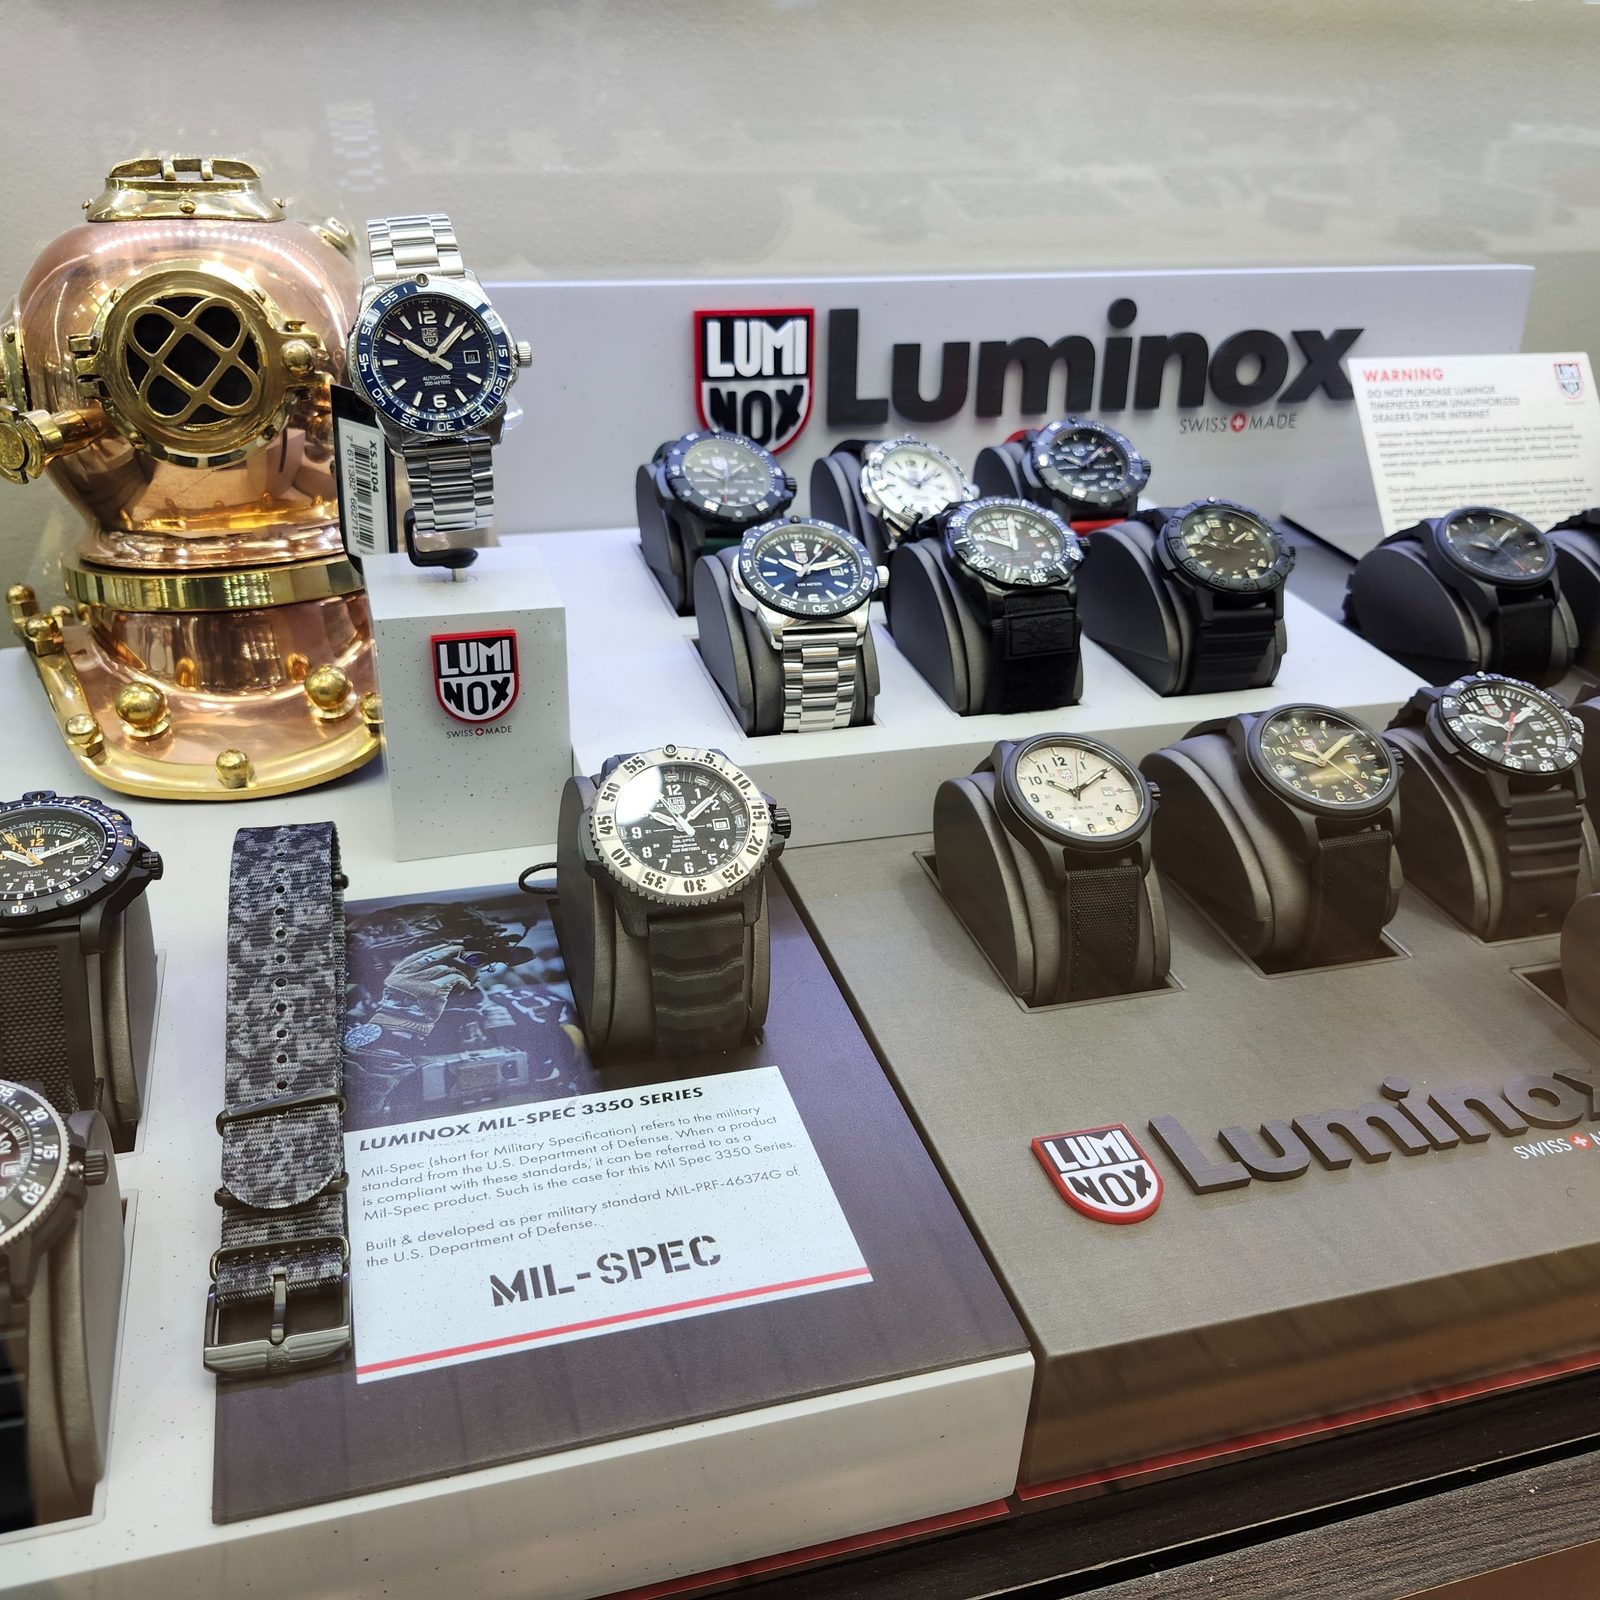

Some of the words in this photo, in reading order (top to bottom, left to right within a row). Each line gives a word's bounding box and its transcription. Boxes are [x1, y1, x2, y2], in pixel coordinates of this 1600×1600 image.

[381, 290, 398, 306] 55
[417, 310, 438, 325] 12
[707, 318, 807, 377] LUMI
[358, 354, 369, 372] 45
[827, 298, 1365, 427] Luminox
[1363, 368, 1444, 382] WARNING
[372, 389, 386, 407] 40
[433, 394, 447, 409] 6
[401, 414, 419, 428] 35
[709, 385, 804, 447] NOX
[1179, 416, 1228, 435] SWISS
[1248, 411, 1298, 430] MADE
[437, 422, 455, 432] 30
[754, 582, 767, 595] 40
[780, 599, 797, 609] 35
[813, 604, 830, 613] 30
[842, 597, 857, 608] 25
[439, 639, 511, 676] LUMI
[443, 677, 510, 716] NOX
[446, 729, 474, 739] SWISS
[485, 725, 513, 735] MADE
[1292, 726, 1309, 737] 12
[1272, 746, 1287, 757] 10
[623, 756, 646, 773] 55
[1051, 756, 1067, 767] 12
[732, 772, 751, 791] 10
[1028, 776, 1043, 786] 10
[602, 783, 621, 802] 50
[666, 784, 682, 796] 12
[695, 788, 701, 799] 1
[711, 800, 720, 811] 2
[751, 803, 767, 820] 15
[598, 815, 613, 835] 45
[631, 827, 641, 839] 9
[29, 838, 45, 847] 12
[719, 838, 729, 850] 4
[746, 836, 763, 856] 20
[611, 848, 632, 868] 40
[642, 846, 652, 858] 8
[708, 853, 718, 865] 5
[105, 865, 119, 878] 20
[659, 859, 668, 870] 7
[684, 862, 694, 874] 6
[642, 871, 667, 890] 35
[722, 863, 744, 883] 25
[684, 878, 707, 893] 30
[64, 890, 81, 902] 25
[11, 905, 28, 914] 30
[30, 1106, 49, 1122] 10
[360, 1122, 471, 1151] LUMINOX
[478, 1107, 576, 1132] MIL-SPEC
[582, 1098, 634, 1115] 3350
[640, 1087, 703, 1106] SERIES
[361, 1161, 425, 1178] Mil-Spec
[429, 1153, 467, 1168] (short
[470, 1149, 489, 1159] for
[494, 1142, 544, 1156] Military
[549, 1124, 637, 1147] Specification)
[641, 1119, 675, 1131] refers
[694, 1114, 712, 1123] the
[717, 1107, 760, 1119] military
[1513, 1138, 1572, 1159] SWISS
[42, 1144, 59, 1160] 15
[361, 1173, 423, 1191] standard
[428, 1170, 458, 1181] from
[463, 1164, 483, 1175] the
[487, 1159, 515, 1170] U.S.
[520, 1146, 597, 1165] Department
[601, 1141, 614, 1151] of
[618, 1135, 673, 1148] Defense.
[675, 1128, 713, 1138] When
[730, 1116, 777, 1132] product
[1043, 1130, 1139, 1172] LUMI
[363, 1198, 373, 1206] is
[377, 1185, 447, 1204] compliant
[450, 1178, 478, 1191] with
[483, 1173, 518, 1185] these
[522, 1160, 591, 1179] standards,
[596, 1157, 603, 1167] it
[607, 1155, 631, 1164] can
[634, 1150, 652, 1160] be
[656, 1140, 705, 1156] referred
[364, 1203, 429, 1221] Mil-Spec
[434, 1192, 491, 1211] product.
[496, 1184, 529, 1198] Such
[533, 1183, 544, 1191] is
[548, 1178, 567, 1188] the
[572, 1174, 602, 1184] case
[606, 1169, 625, 1178] for
[629, 1165, 650, 1175] this
[655, 1158, 675, 1170] Mil
[679, 1155, 712, 1166] Spec
[715, 1146, 751, 1160] 3350
[754, 1141, 796, 1153] Series.
[1068, 1164, 1152, 1207] NOX
[23, 1182, 46, 1206] 20
[366, 1237, 397, 1252] Built
[401, 1235, 413, 1245] &
[417, 1219, 495, 1242] developed
[499, 1219, 516, 1227] as
[520, 1214, 543, 1226] per
[547, 1203, 598, 1219] military
[602, 1190, 661, 1209] standard
[666, 1169, 781, 1198] MIL-PRF-46374G
[786, 1165, 799, 1176] of
[366, 1256, 388, 1268] the
[394, 1249, 424, 1262] U.S.
[429, 1232, 514, 1256] Department
[519, 1228, 532, 1240] of
[536, 1220, 597, 1236] Defense.
[490, 1235, 721, 1307] MIL-SPEC
